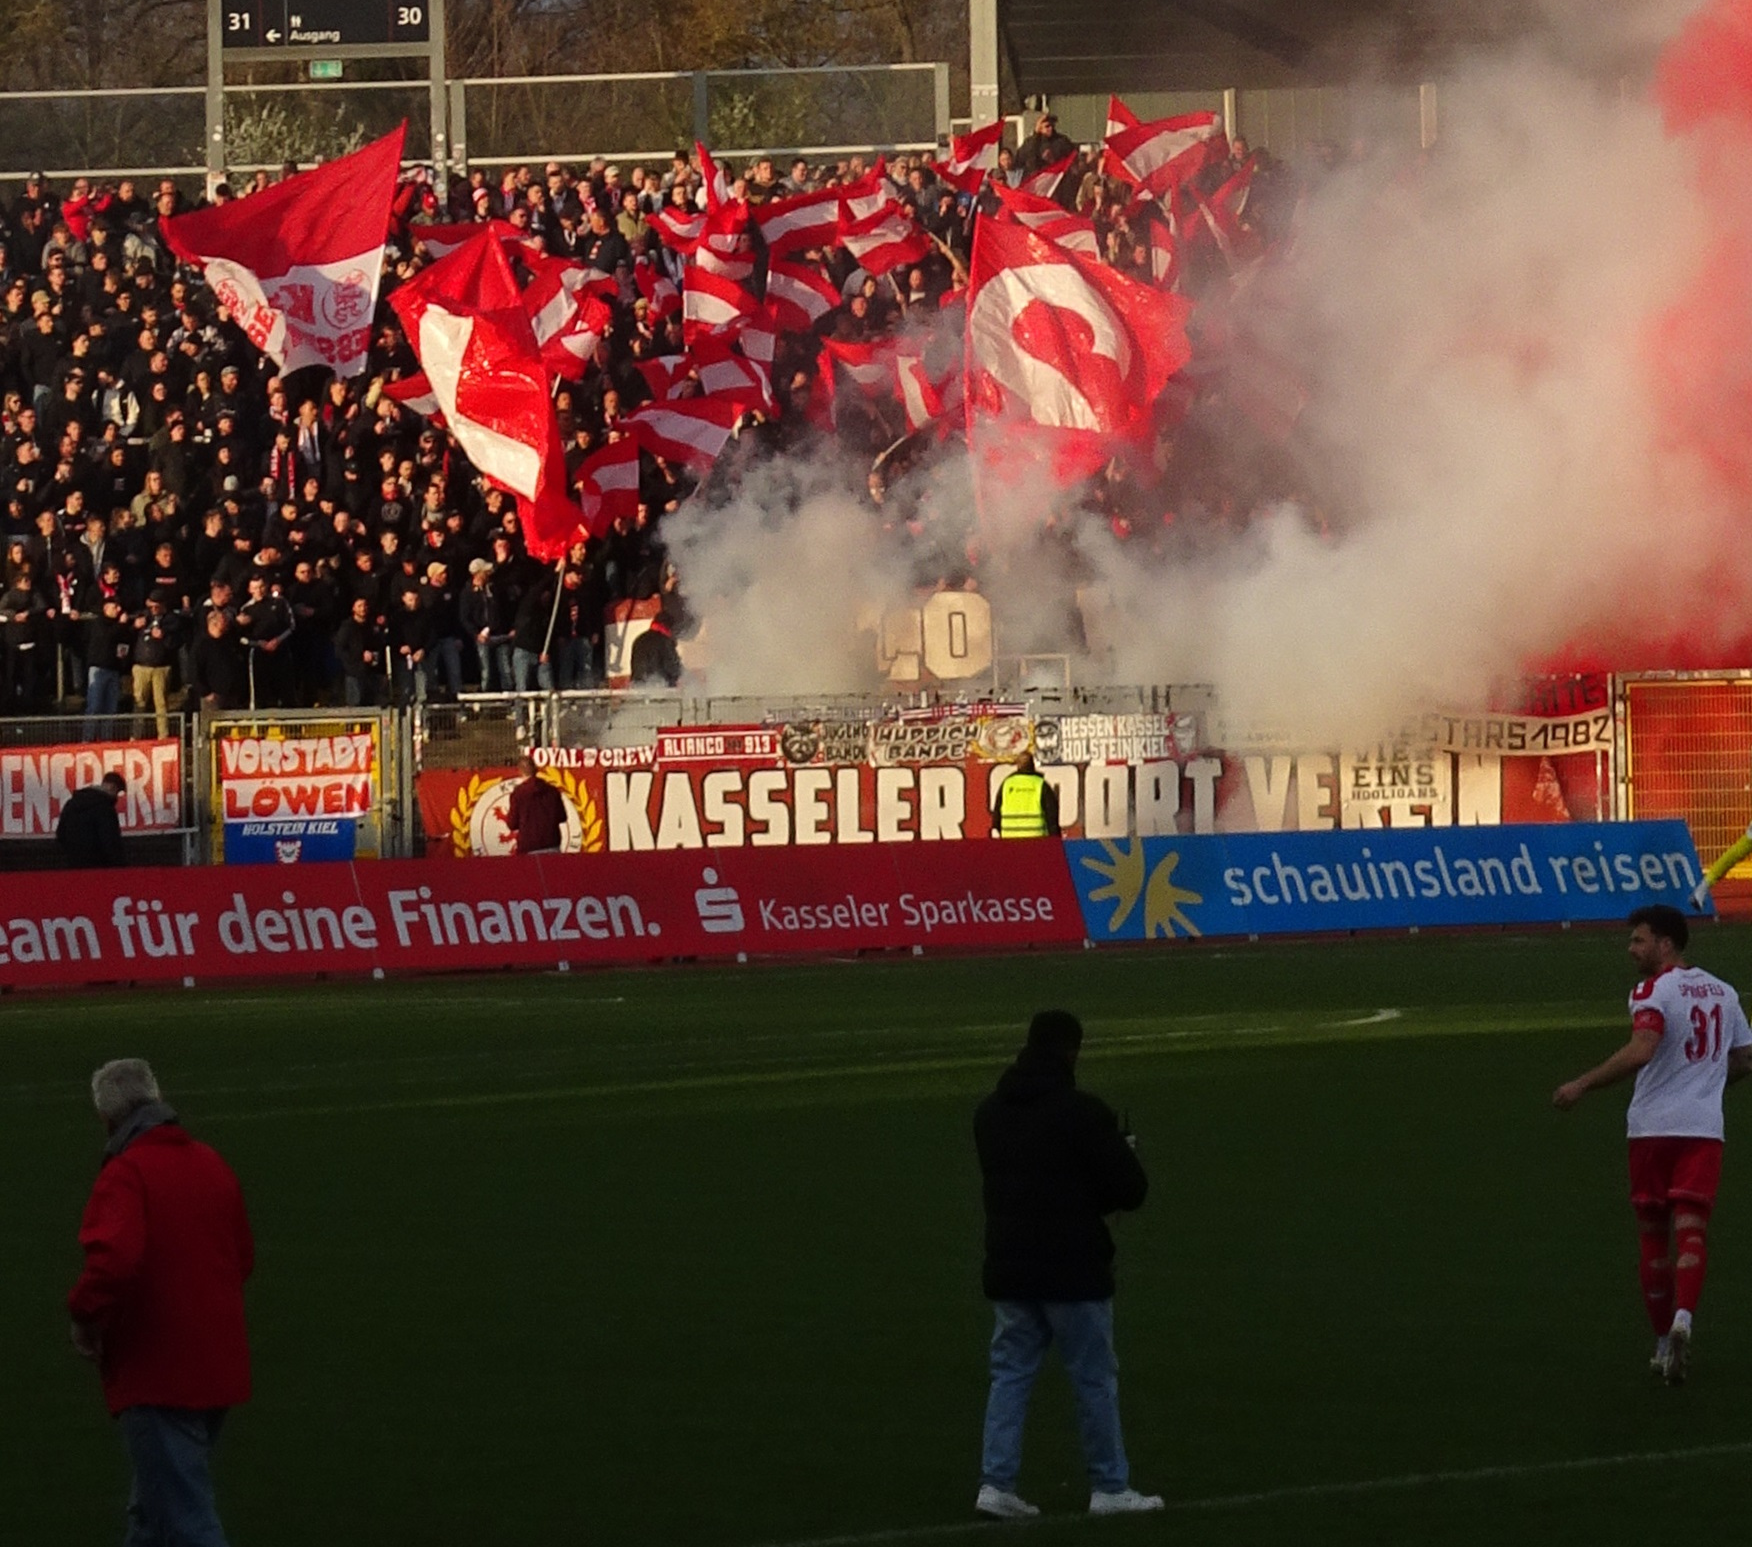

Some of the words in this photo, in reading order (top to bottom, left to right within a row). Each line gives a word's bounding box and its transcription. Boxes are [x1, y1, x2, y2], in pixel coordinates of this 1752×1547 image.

[228, 12, 250, 30] 31
[397, 7, 422, 25] 30
[290, 29, 341, 42] Ausgang
[1061, 715, 1115, 738] HESSEN
[1116, 713, 1169, 737] KASSEL
[223, 737, 370, 775] VORSTADT
[524, 745, 582, 767] OYAL
[600, 744, 656, 767] CREW
[744, 735, 771, 754] 913
[887, 742, 966, 759] BANDE
[1062, 737, 1133, 761] HOLSTEIN
[1134, 737, 1167, 758] KIEL
[1352, 764, 1435, 787] EINS
[225, 779, 370, 819] LÖWEN
[606, 768, 966, 852] KASSELER
[990, 757, 1223, 840] PORT
[1352, 787, 1438, 801] HOOLIGANS
[242, 822, 304, 837] HOLSTEIN
[307, 821, 339, 836] KIEL
[1224, 842, 1542, 906] schauinsland
[1548, 841, 1696, 893] reisen
[112, 897, 199, 957] für
[219, 891, 378, 954] deine
[388, 886, 662, 947] Finanzen.
[759, 895, 889, 931] Kasseler
[900, 891, 1055, 933] Sparkasse
[1684, 1003, 1723, 1065] 31
